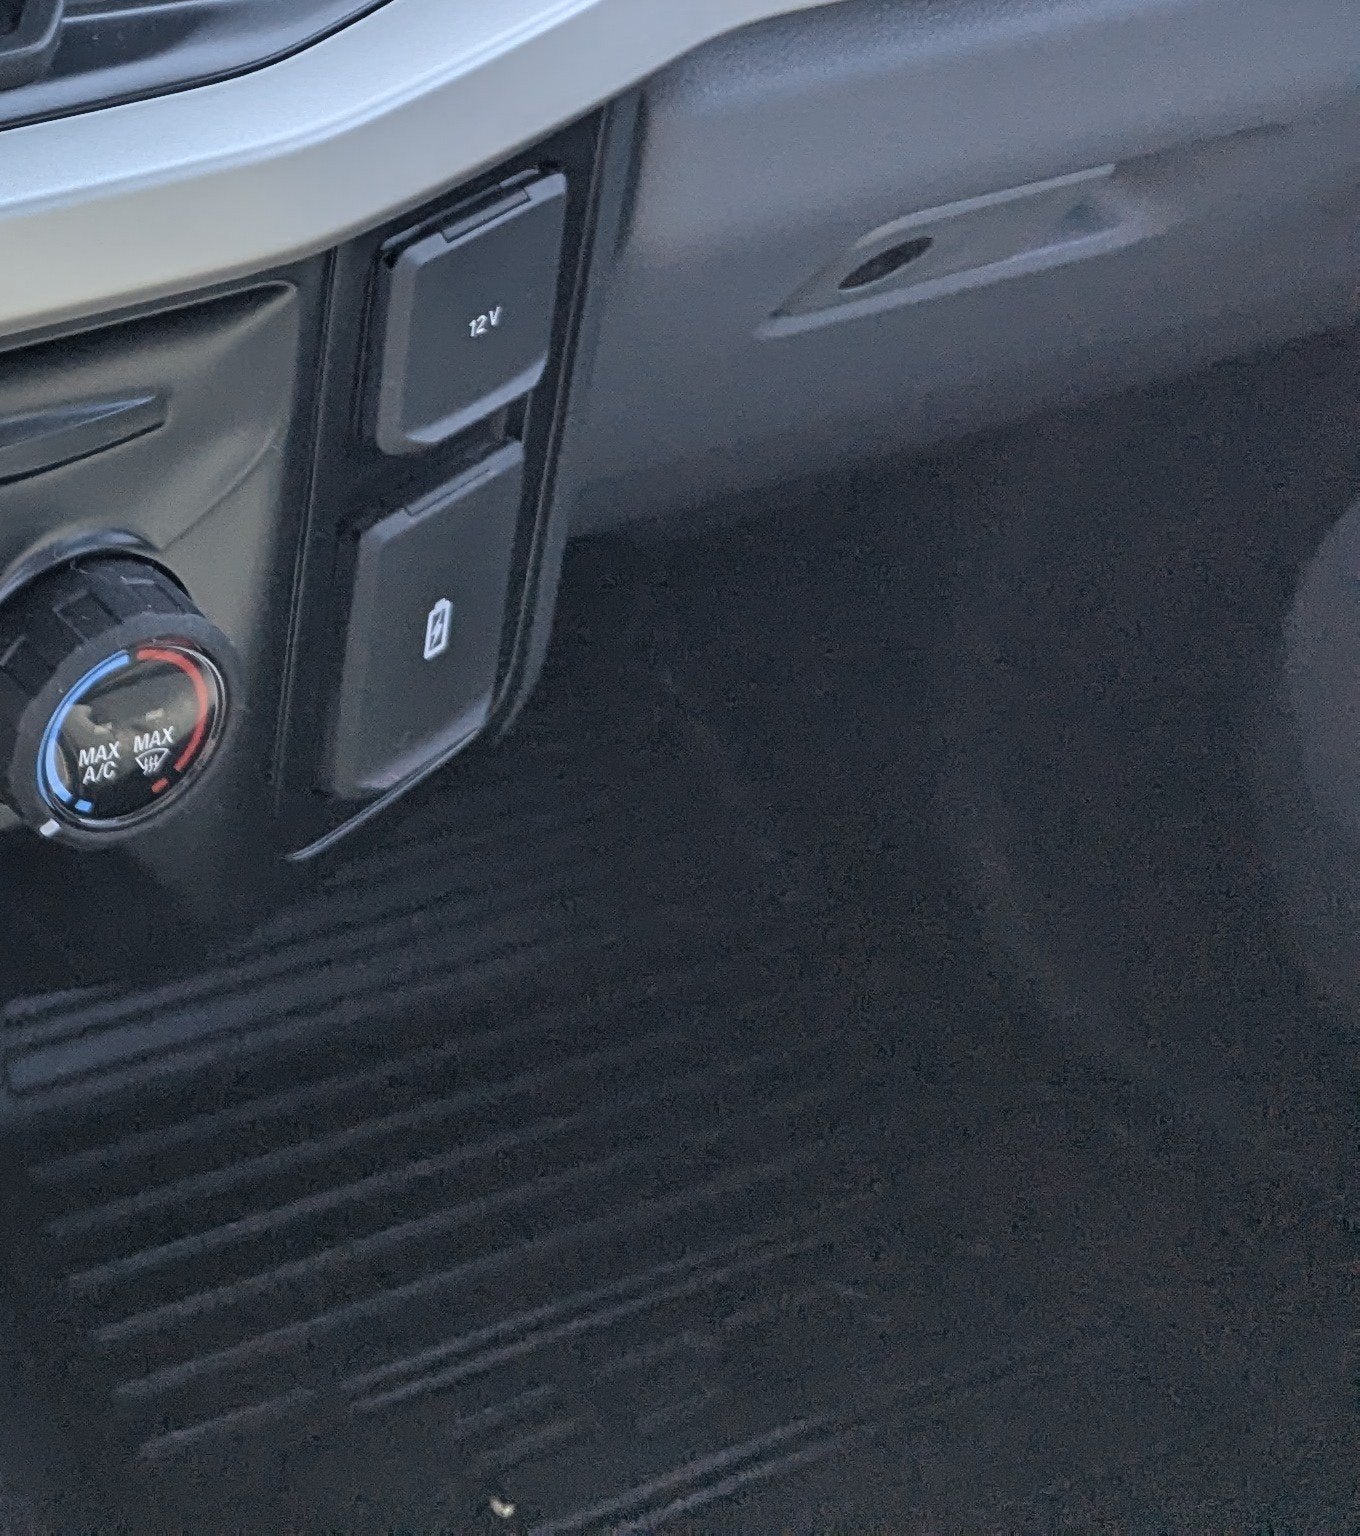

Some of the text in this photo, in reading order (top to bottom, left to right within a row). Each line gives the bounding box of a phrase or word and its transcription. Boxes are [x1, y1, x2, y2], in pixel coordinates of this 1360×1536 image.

[133, 725, 175, 754] MAX
[78, 741, 121, 768] MAX
[83, 760, 117, 785] A/C
